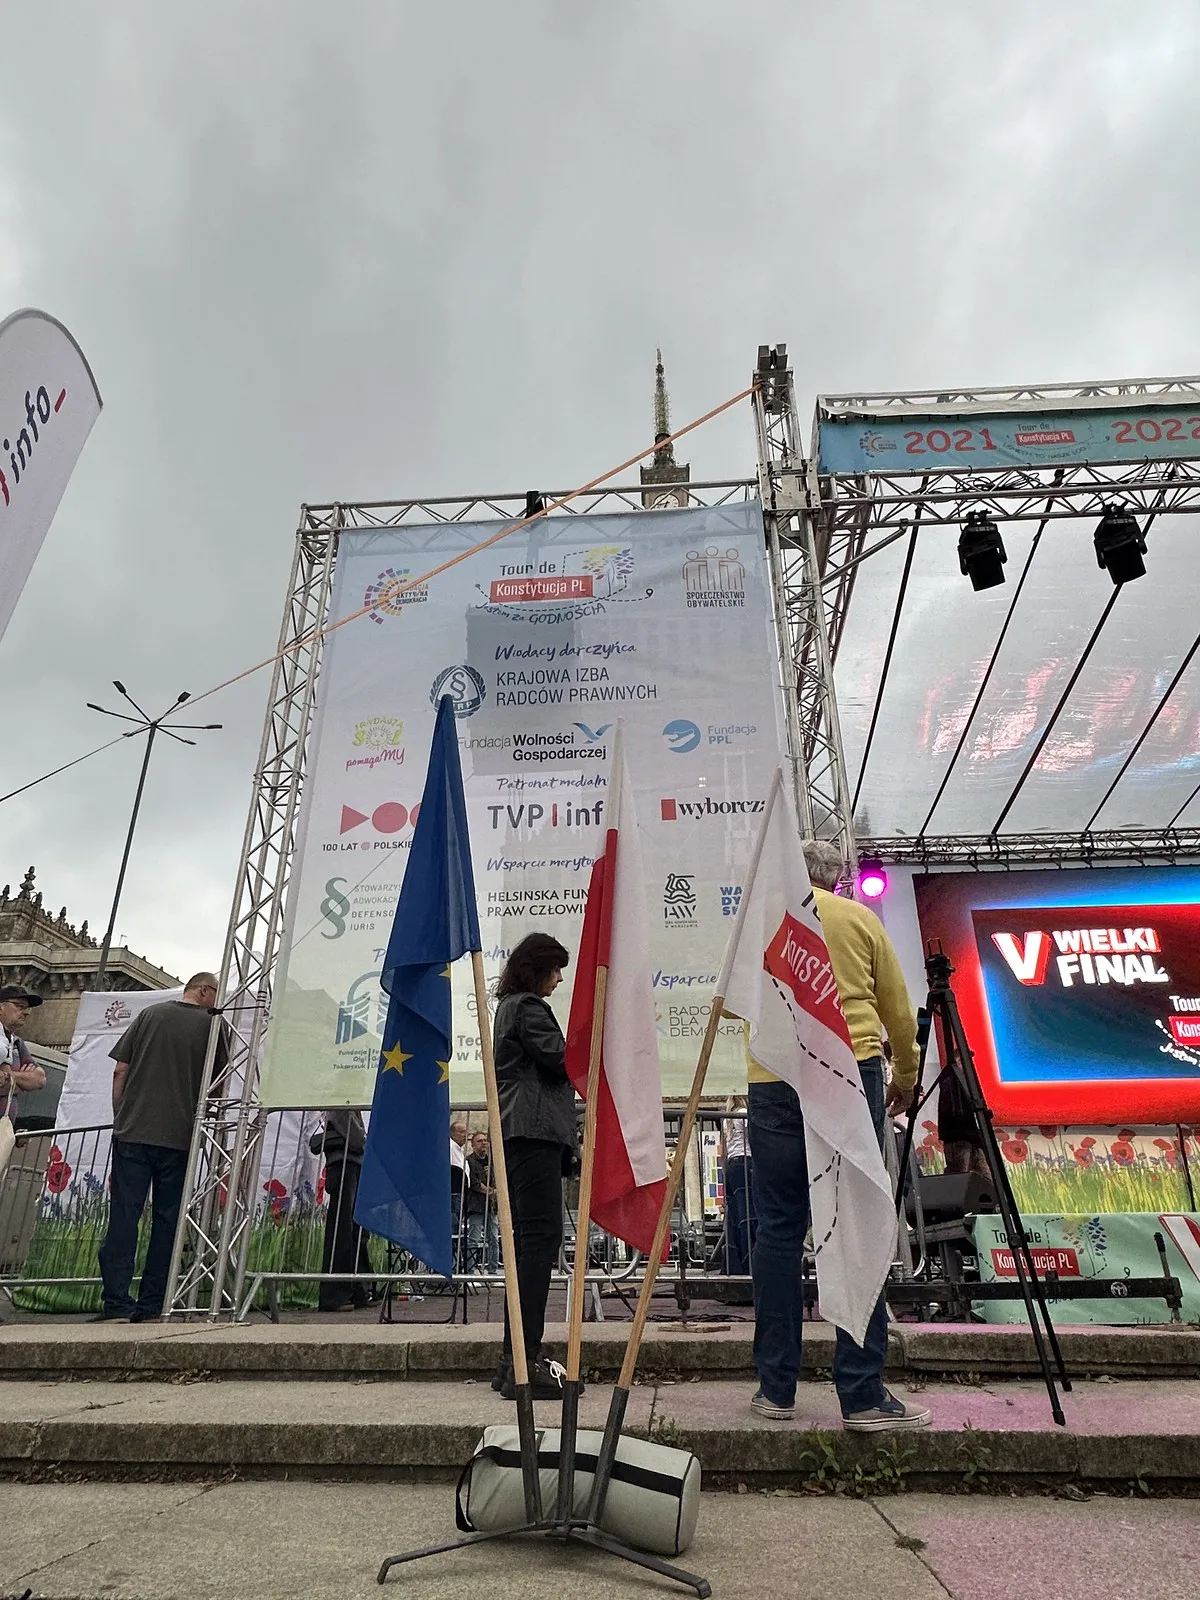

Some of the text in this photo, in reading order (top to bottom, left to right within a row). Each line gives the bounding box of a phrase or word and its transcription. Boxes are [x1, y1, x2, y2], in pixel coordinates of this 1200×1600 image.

[1017, 422, 1050, 431] Tour de
[4, 386, 50, 483] info
[903, 428, 997, 454] 2021
[1018, 432, 1071, 443] Konstytucja PL
[500, 561, 556, 576] Tour de
[496, 580, 586, 597] Konstytucja PL
[686, 590, 745, 600] SPOŁECZEŃSTWO
[687, 600, 745, 608] OBYWATELSKIE
[559, 641, 637, 659] darczyńca
[496, 667, 610, 686] KRAJOWA IZBA
[496, 684, 657, 706] RADCÓW PRAWNYCH
[707, 725, 757, 735] Fundacja
[512, 732, 574, 746] Wolności
[708, 735, 732, 744] PPL
[512, 745, 606, 762] Gospodarczej
[496, 775, 608, 790] Patronat medialn
[487, 801, 604, 829] TVP inf
[322, 841, 412, 851] 100 LAT POLSKIE
[487, 857, 546, 871] Wsparcie
[353, 896, 398, 904] ADWOKACK
[488, 888, 588, 902] HELSIŃSKA FUN
[352, 910, 394, 918] DEFENSO
[487, 903, 586, 917] PRAW CZŁOWI
[1052, 928, 1160, 953] WIELKI
[992, 931, 1050, 984] V
[1056, 954, 1170, 987] FINAŁ
[669, 1005, 711, 1016] RADO
[669, 1016, 699, 1026] DLA
[670, 1026, 745, 1037] DEMKRA
[457, 1053, 469, 1061] w
[1058, 1252, 1073, 1268] PL
